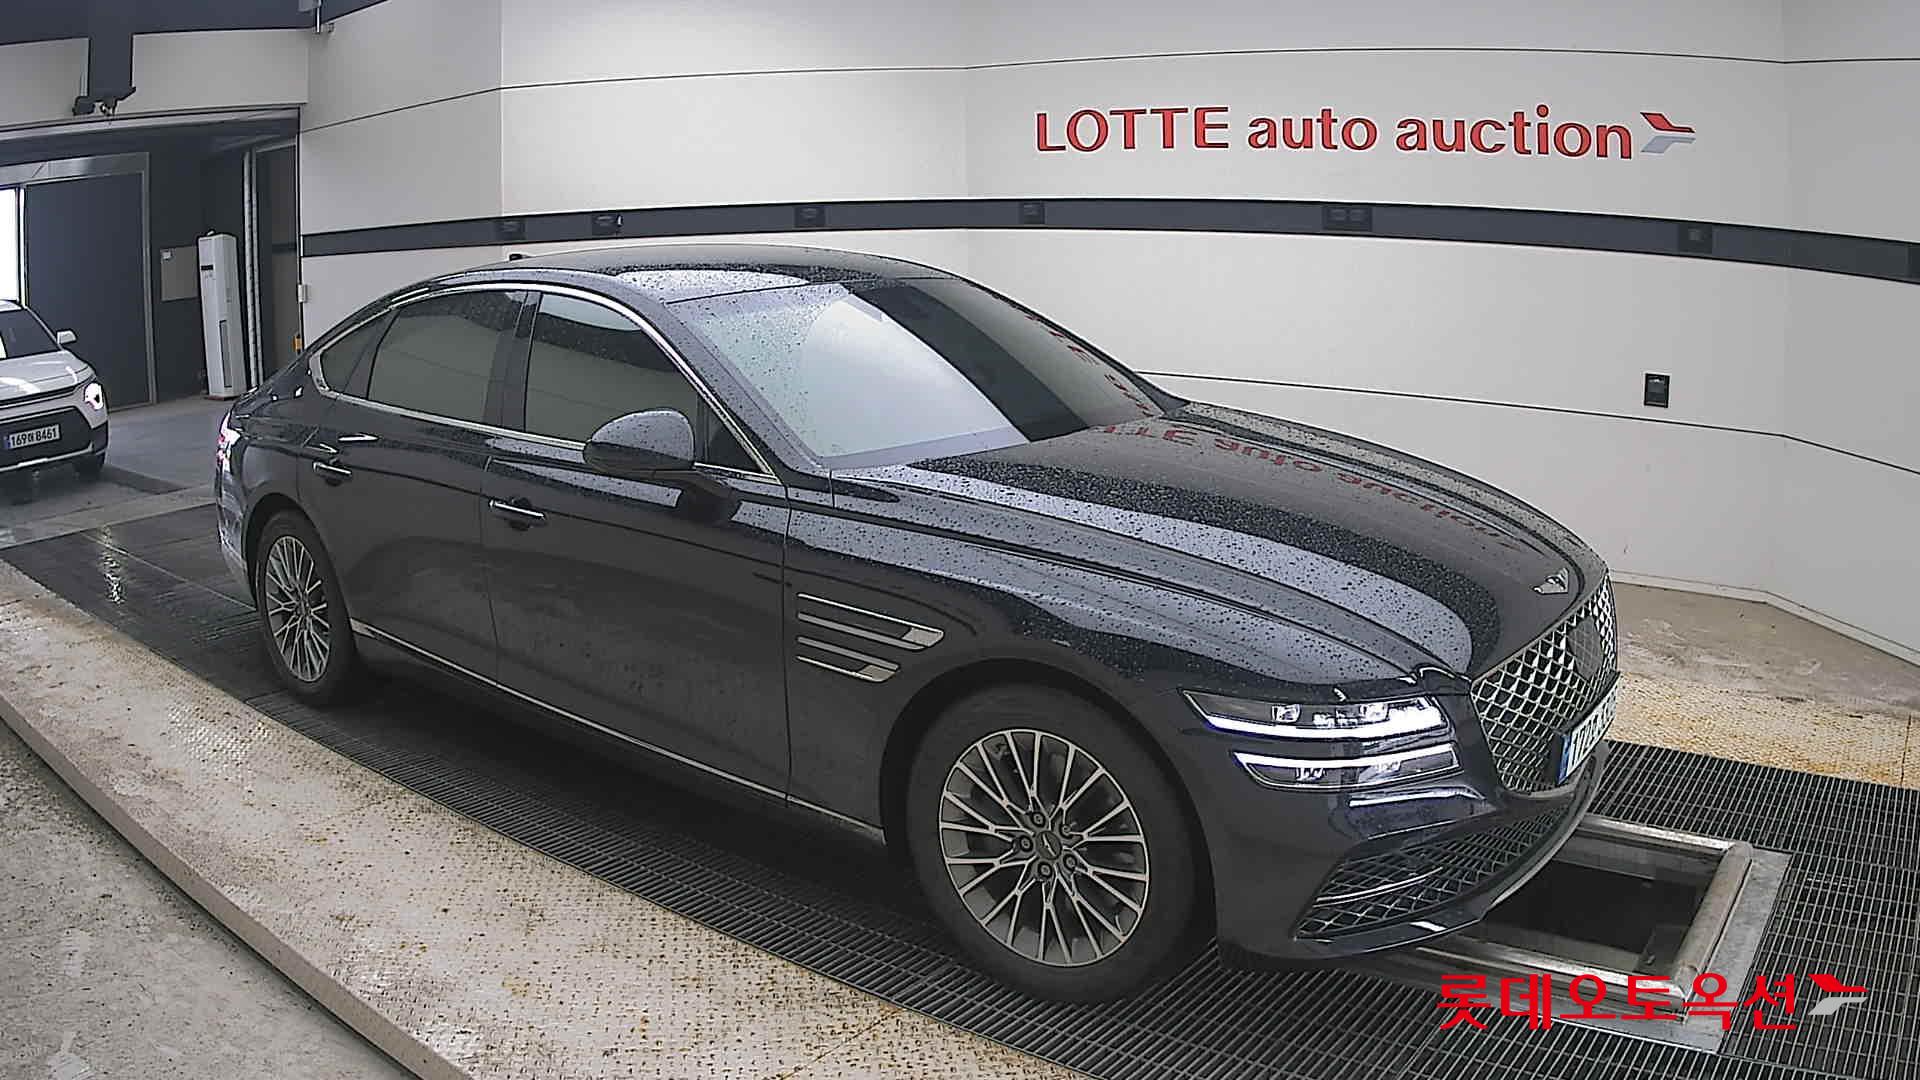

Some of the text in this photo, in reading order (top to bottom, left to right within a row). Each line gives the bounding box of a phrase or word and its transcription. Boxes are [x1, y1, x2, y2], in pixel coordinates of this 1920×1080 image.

[1036, 103, 1633, 160] LOTTE auto auction
